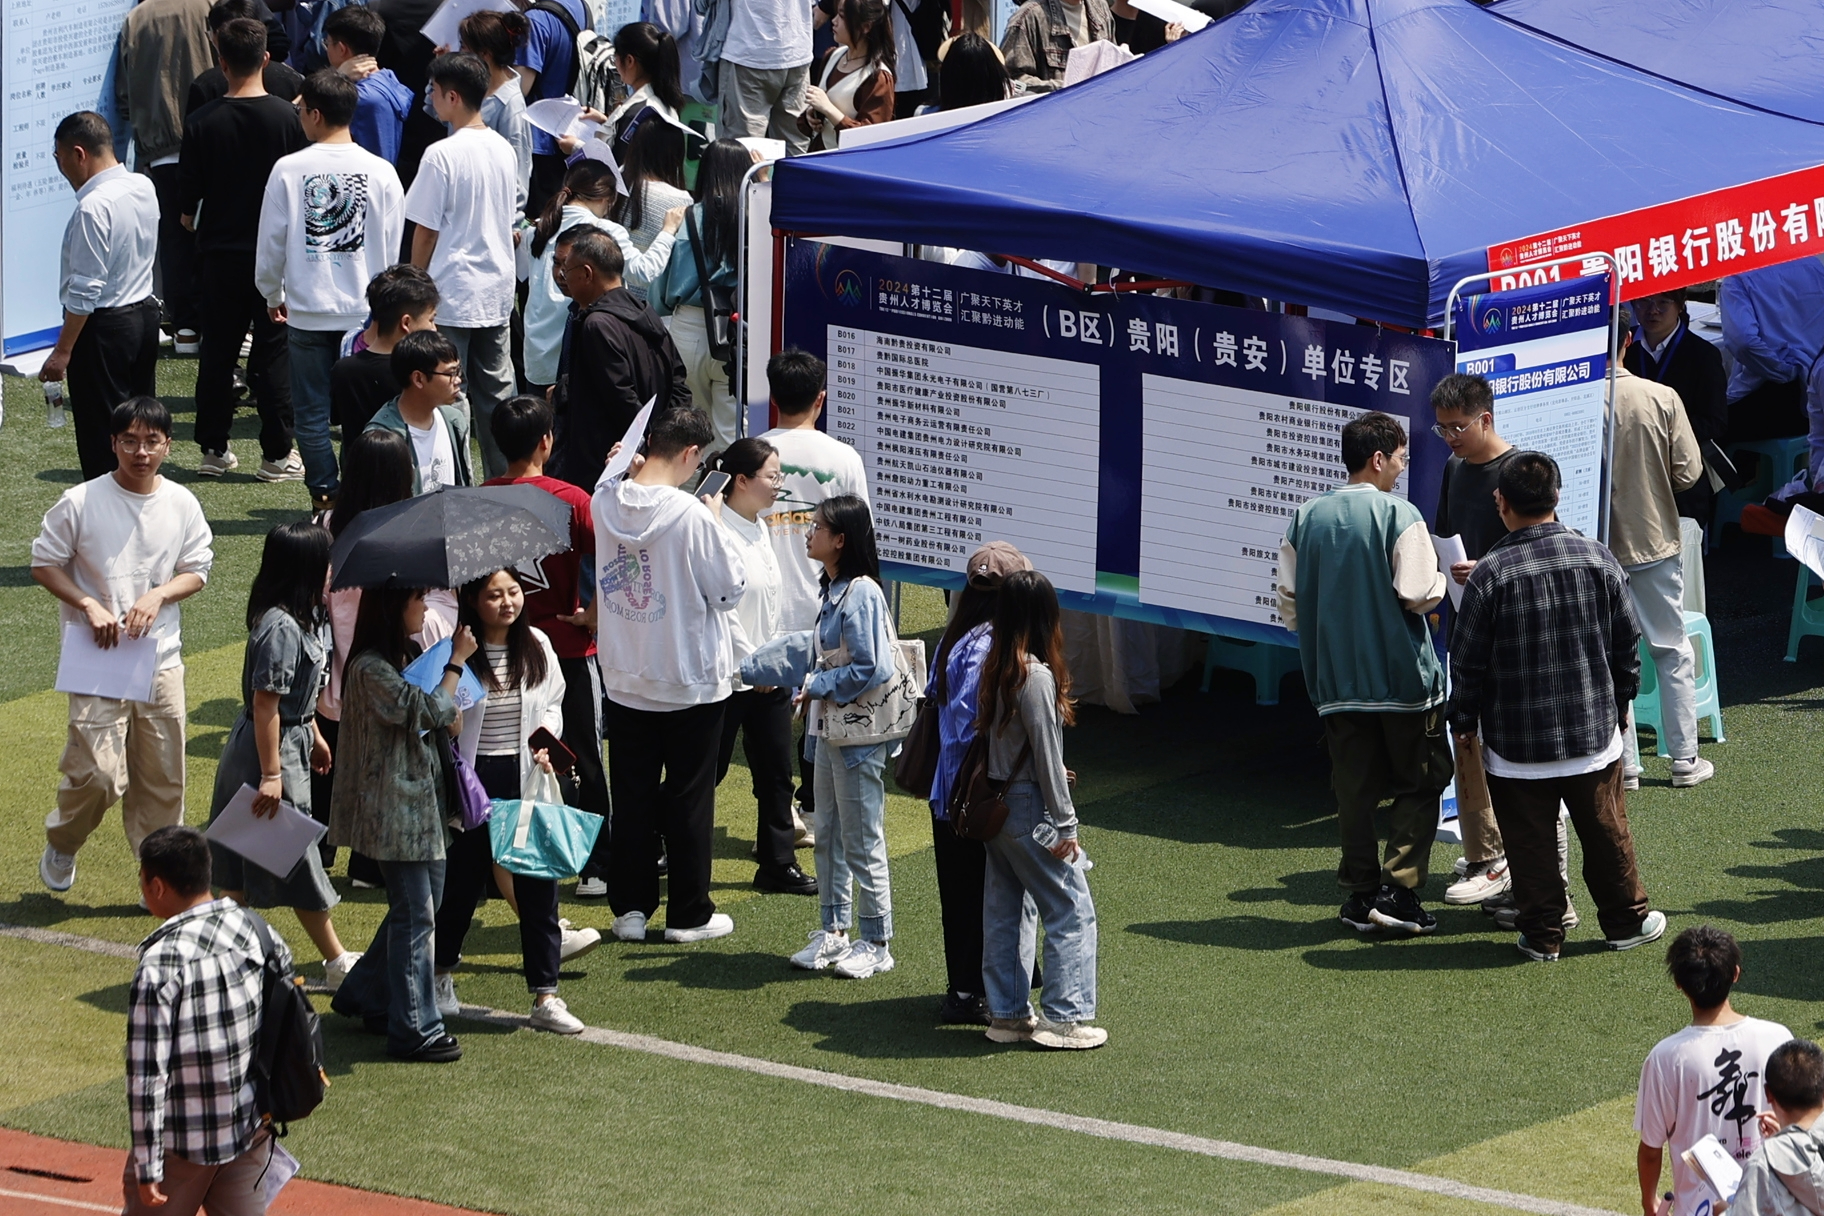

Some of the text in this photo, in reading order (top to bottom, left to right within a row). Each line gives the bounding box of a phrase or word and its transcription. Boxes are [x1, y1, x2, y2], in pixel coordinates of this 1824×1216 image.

[878, 279, 953, 305] 2024第十二届
[961, 293, 1023, 313] 广聚天下英才
[1562, 292, 1601, 307] 广聚天下英才
[878, 292, 953, 317] 贵州人才博览会
[1512, 299, 1558, 316] 2024第十二届
[960, 310, 1025, 331] 汇聚黔进动能
[1511, 310, 1558, 325] 贵州人才博览会
[837, 330, 951, 356] B016 海南黔贵投资有限公司
[837, 345, 929, 367] B017 贵黔国际总医院
[837, 361, 855, 370] B018
[1467, 359, 1495, 375] B001
[837, 376, 1006, 408] B019 贵阳市医疗健康产业投资股份有限公司
[837, 391, 960, 417] B020 贵州振华新材料有限公司
[837, 406, 991, 436] B021 贵州电子商务云运营有限责任公司
[1259, 411, 1343, 434] 贵阳农村商业银行股份有
[837, 421, 1021, 456] B022 中国电建集团贵州电力设计研究院有限公司
[877, 442, 967, 463] 贵州枫阳液压有限责任公司
[877, 457, 983, 481] 贵州航天凯山石油仪器有限公司
[1251, 456, 1350, 480] 贵阳市城市建设投资集团有限
[877, 472, 967, 494] 贵州詹阳动力重工有限公司
[876, 487, 1013, 516] 贵州省水利水电勘测设计研究院有限公司
[876, 502, 982, 527] 中国电建集团贵州工程有限公司
[876, 518, 982, 542] 中铁八局集团第三工程有限公司
[876, 532, 966, 554] 贵州一树药业股份有限公司
